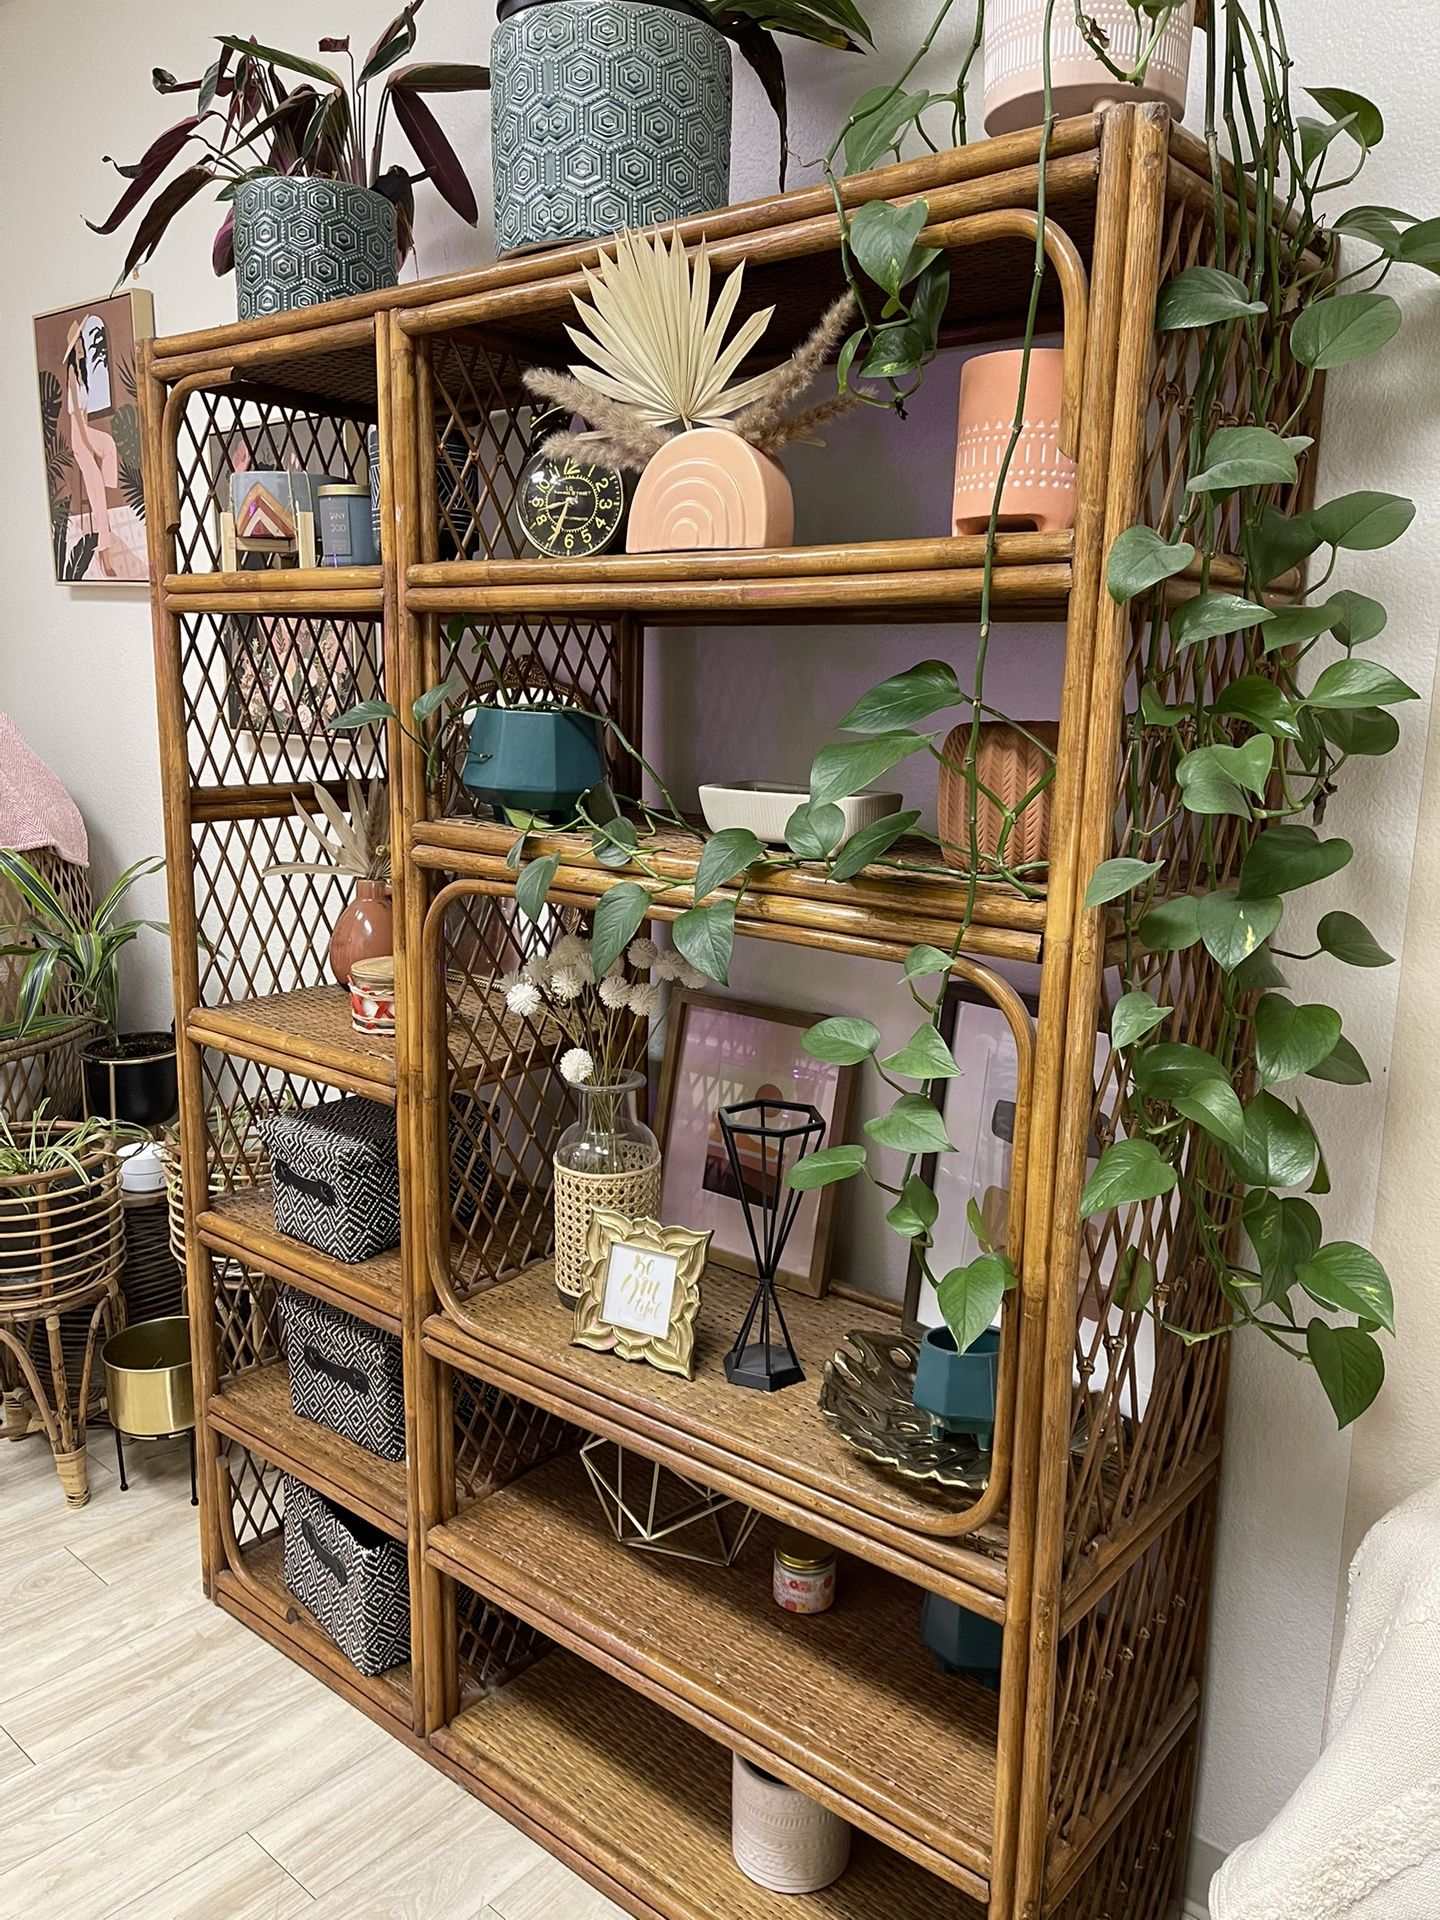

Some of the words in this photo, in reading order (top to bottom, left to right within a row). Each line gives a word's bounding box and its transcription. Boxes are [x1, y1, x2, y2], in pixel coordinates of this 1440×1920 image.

[535, 479, 551, 494] 10
[595, 478, 609, 492] 2
[531, 497, 545, 508] 9
[598, 499, 613, 509] 3
[535, 514, 548, 526] 8
[595, 516, 606, 529] 4
[564, 534, 574, 549] 6
[580, 528, 592, 543] 5
